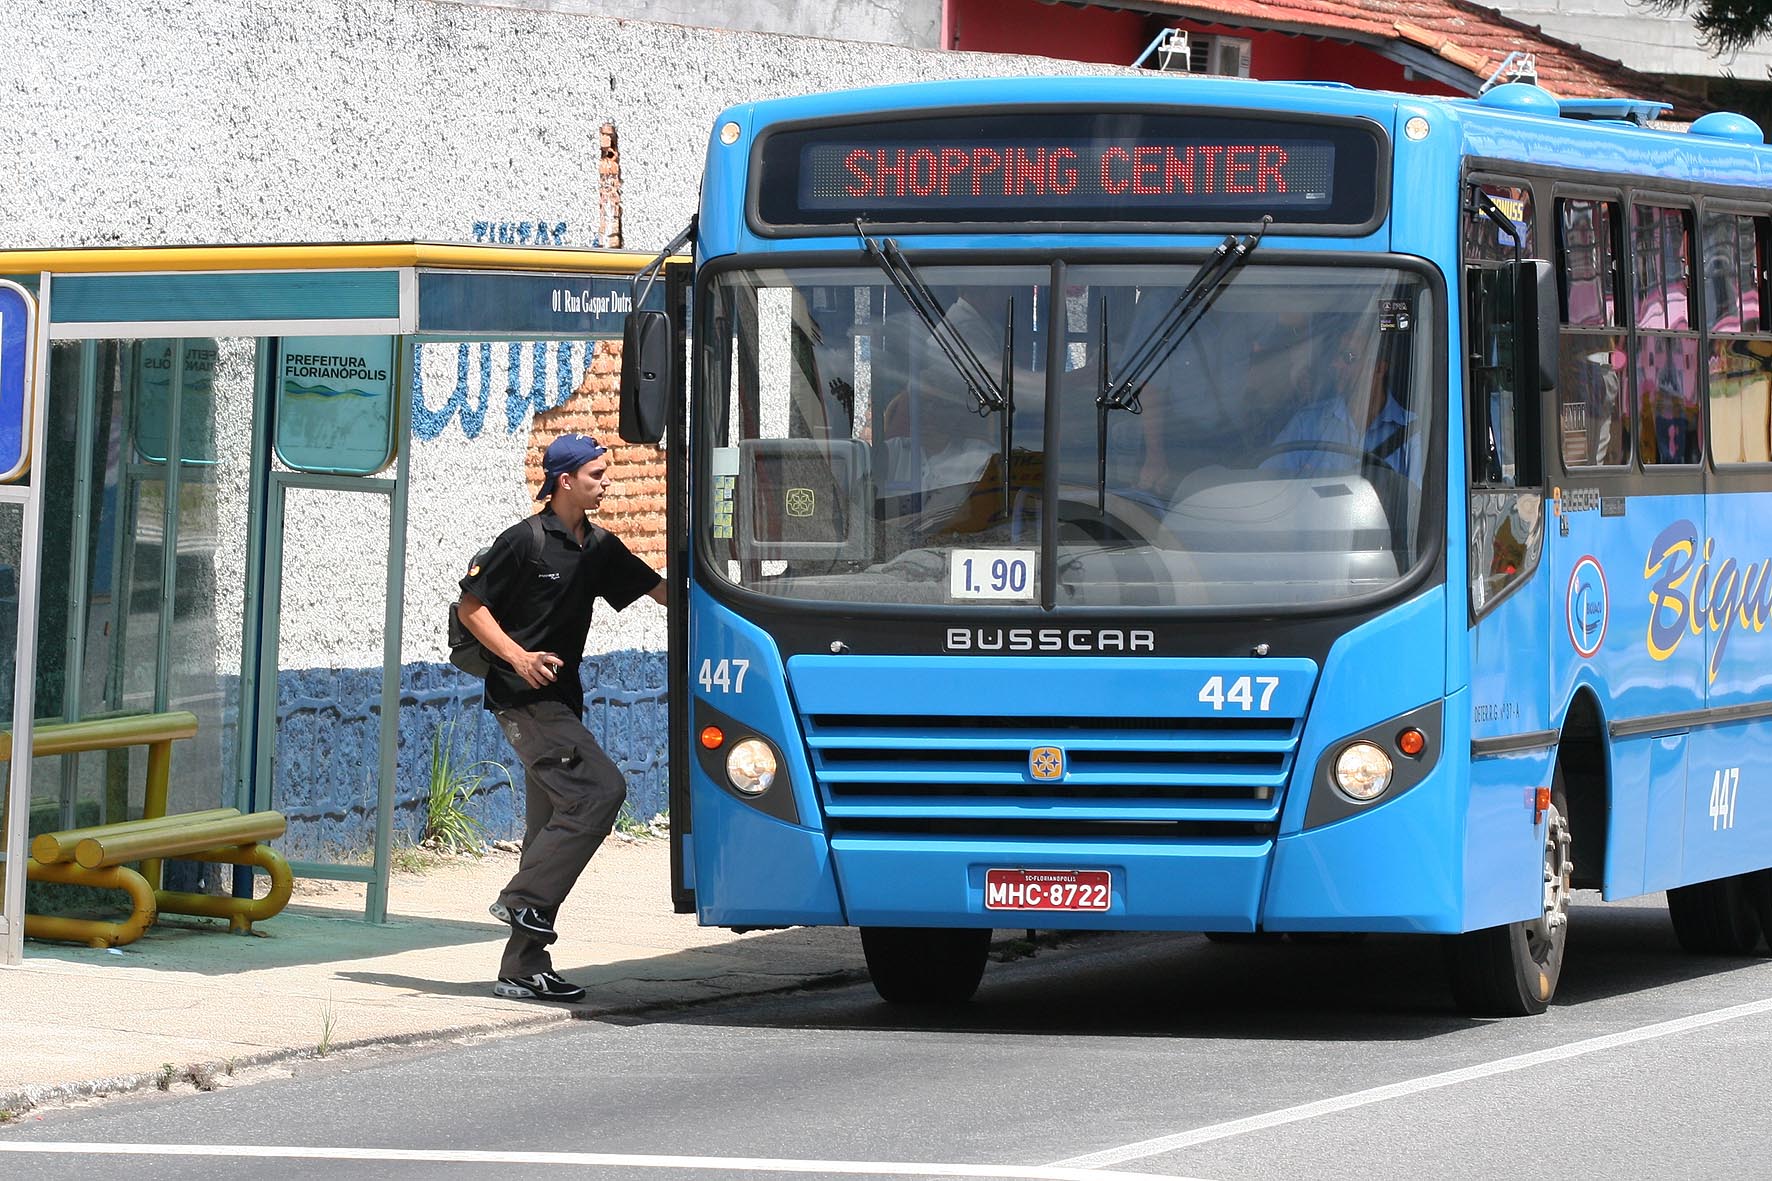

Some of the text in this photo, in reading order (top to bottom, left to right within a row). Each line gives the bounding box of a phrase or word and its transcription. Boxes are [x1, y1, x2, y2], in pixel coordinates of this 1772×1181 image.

[844, 145, 1289, 197] SHOPPING CENTER
[552, 289, 561, 312] 01
[564, 289, 580, 313] Rua
[285, 354, 366, 368] PREFEITURA
[285, 366, 387, 381] FLORIANÓPOLIS
[1644, 519, 1772, 685] Bigu
[946, 628, 1155, 650] BUSSCAR
[698, 658, 749, 693] 447
[1198, 676, 1280, 711] 447
[1708, 767, 1739, 831] 447
